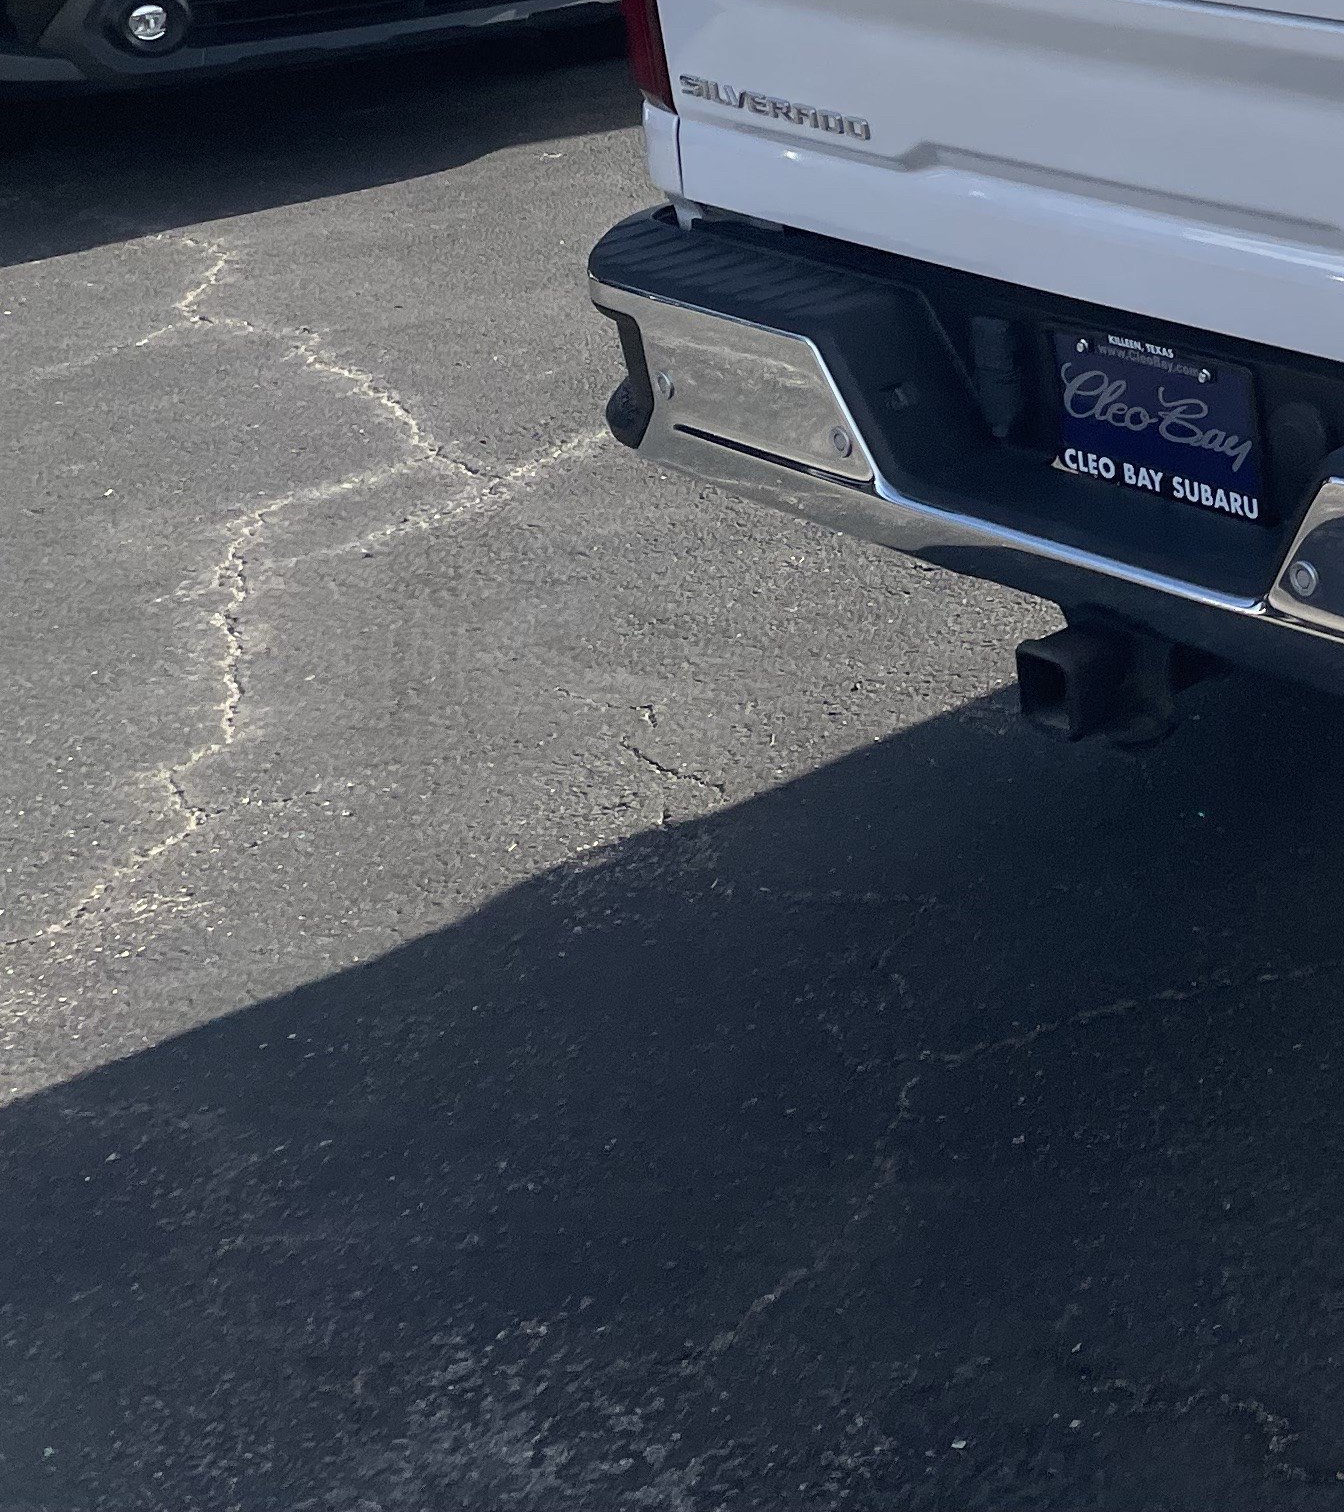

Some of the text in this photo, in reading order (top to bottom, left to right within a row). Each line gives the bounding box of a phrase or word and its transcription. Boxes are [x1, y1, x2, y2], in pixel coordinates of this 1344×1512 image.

[679, 73, 871, 141] SILVERADO
[1107, 334, 1174, 359] KILLEEN, TEXAS
[1060, 362, 1252, 472] Cleo Bay
[1064, 448, 1260, 520] CLEO BAY SUBARU
